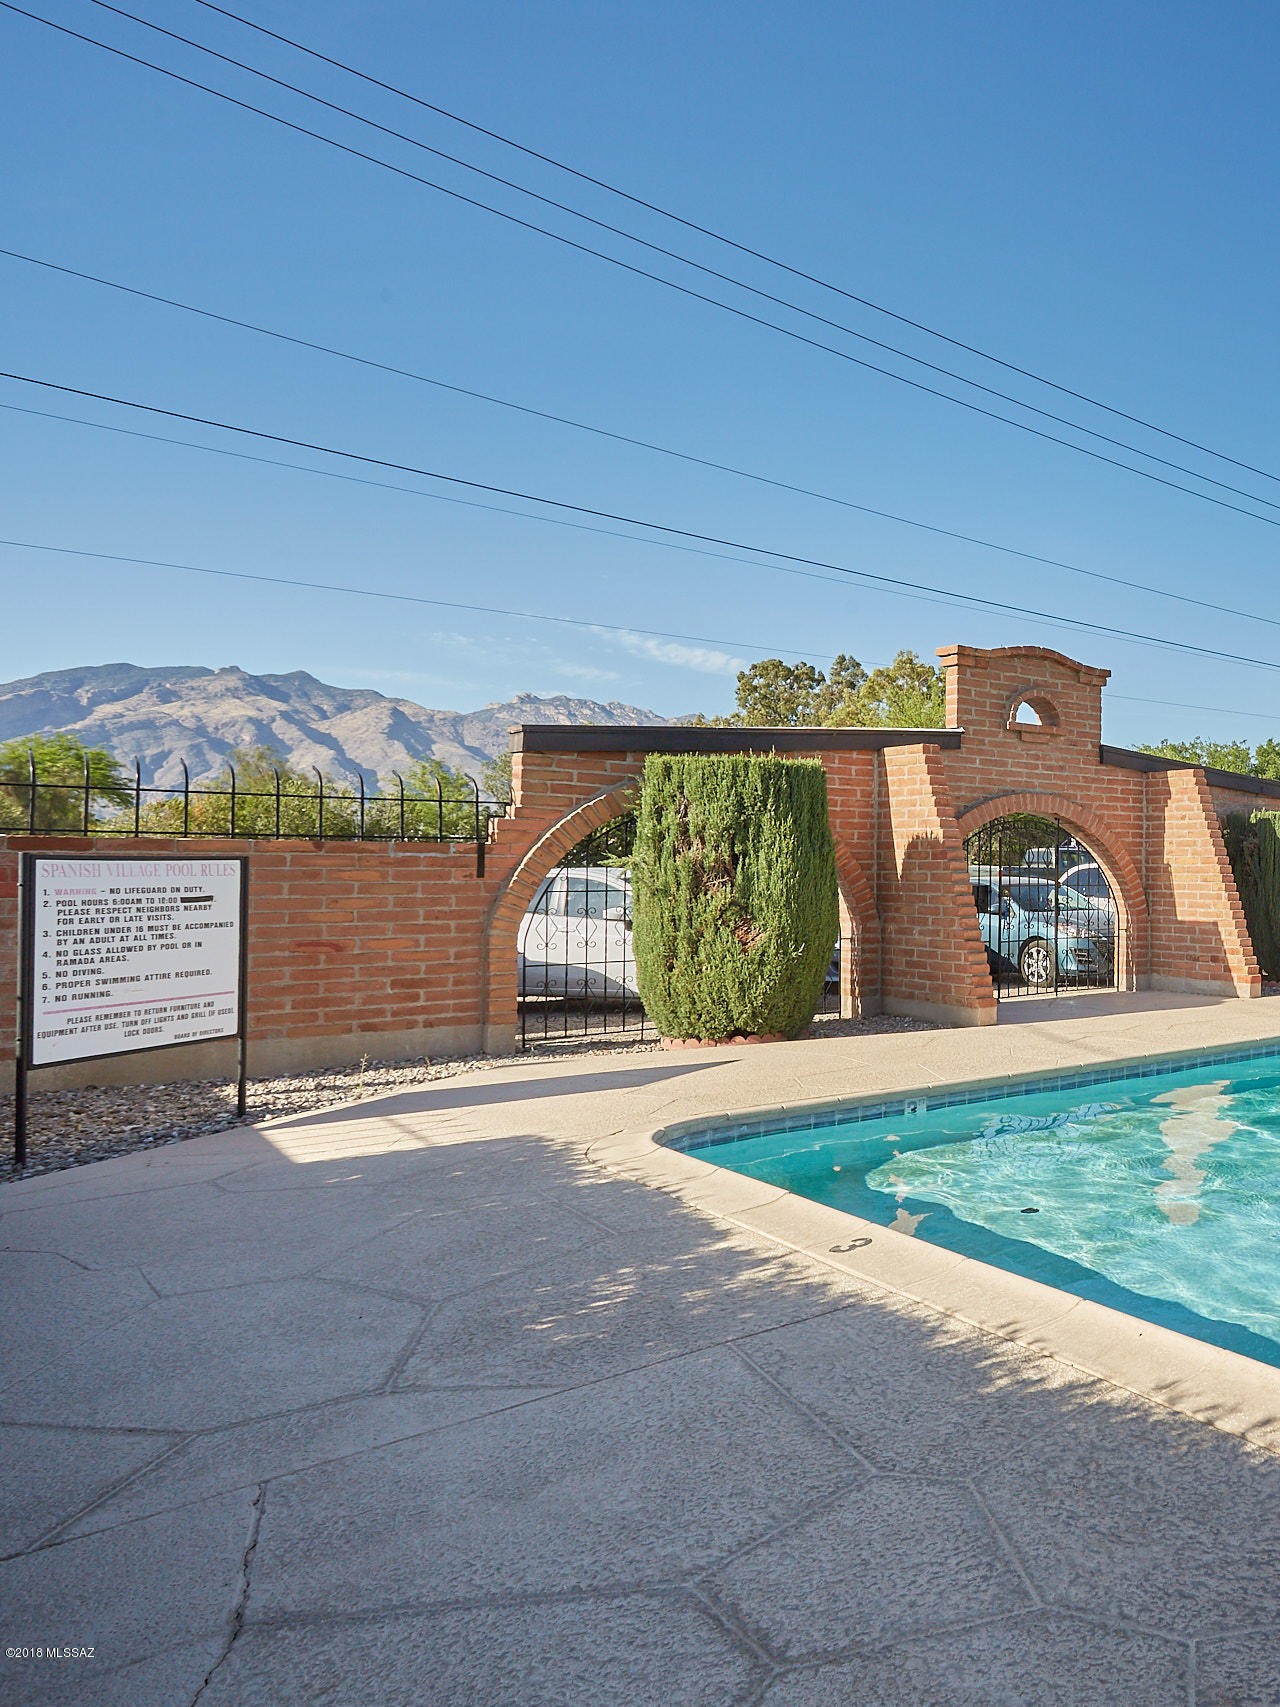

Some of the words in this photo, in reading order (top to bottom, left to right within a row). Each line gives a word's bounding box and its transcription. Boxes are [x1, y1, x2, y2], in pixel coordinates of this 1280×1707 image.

[41, 863, 101, 878] SPANISH
[106, 863, 160, 877] VILLAGE
[165, 863, 196, 877] POOL
[201, 863, 236, 877] RULES
[54, 888, 97, 896] WARNING
[124, 886, 167, 895] LIFEGUARD
[43, 900, 52, 908] 2.
[112, 898, 142, 906] 6:00AM
[57, 908, 91, 916] PLEASE
[95, 907, 133, 915] RESPECT
[136, 905, 180, 913] NEIGHBORS
[78, 917, 106, 925] EARLY
[124, 915, 143, 923] LATE
[56, 928, 100, 937] CHILDREN
[147, 924, 169, 932] MUST
[185, 921, 234, 930] ACCOMPANIED
[57, 938, 68, 946] BY
[89, 936, 116, 944] ADULT
[133, 934, 147, 942] ALL
[73, 948, 102, 956] GLASS
[106, 945, 144, 954] ALLOWED
[56, 957, 95, 966] RAMADA
[99, 955, 130, 963] AREAS.
[55, 970, 68, 978] NO
[72, 968, 104, 977] DIVING.
[55, 980, 91, 990] PROPER
[95, 975, 141, 986] SWIMMING
[144, 972, 171, 981] ATTIRE
[175, 969, 212, 978] REQUIRED.
[55, 994, 67, 1002] NO
[71, 991, 113, 1001] RUNNING.
[67, 1015, 92, 1025] PLEASE
[94, 1010, 131, 1021] REMEMBER
[144, 1006, 168, 1015] RETURN
[169, 1002, 201, 1012] FURNITURE
[37, 1027, 78, 1039] EQUIPMENT
[80, 1024, 101, 1033] AFTER
[122, 1020, 138, 1028] TURN
[141, 1018, 152, 1026] OFF
[154, 1015, 175, 1024] LIGHTS
[176, 1013, 189, 1021] AND
[191, 1010, 206, 1019] GRILL
[124, 1029, 140, 1038] LOCK
